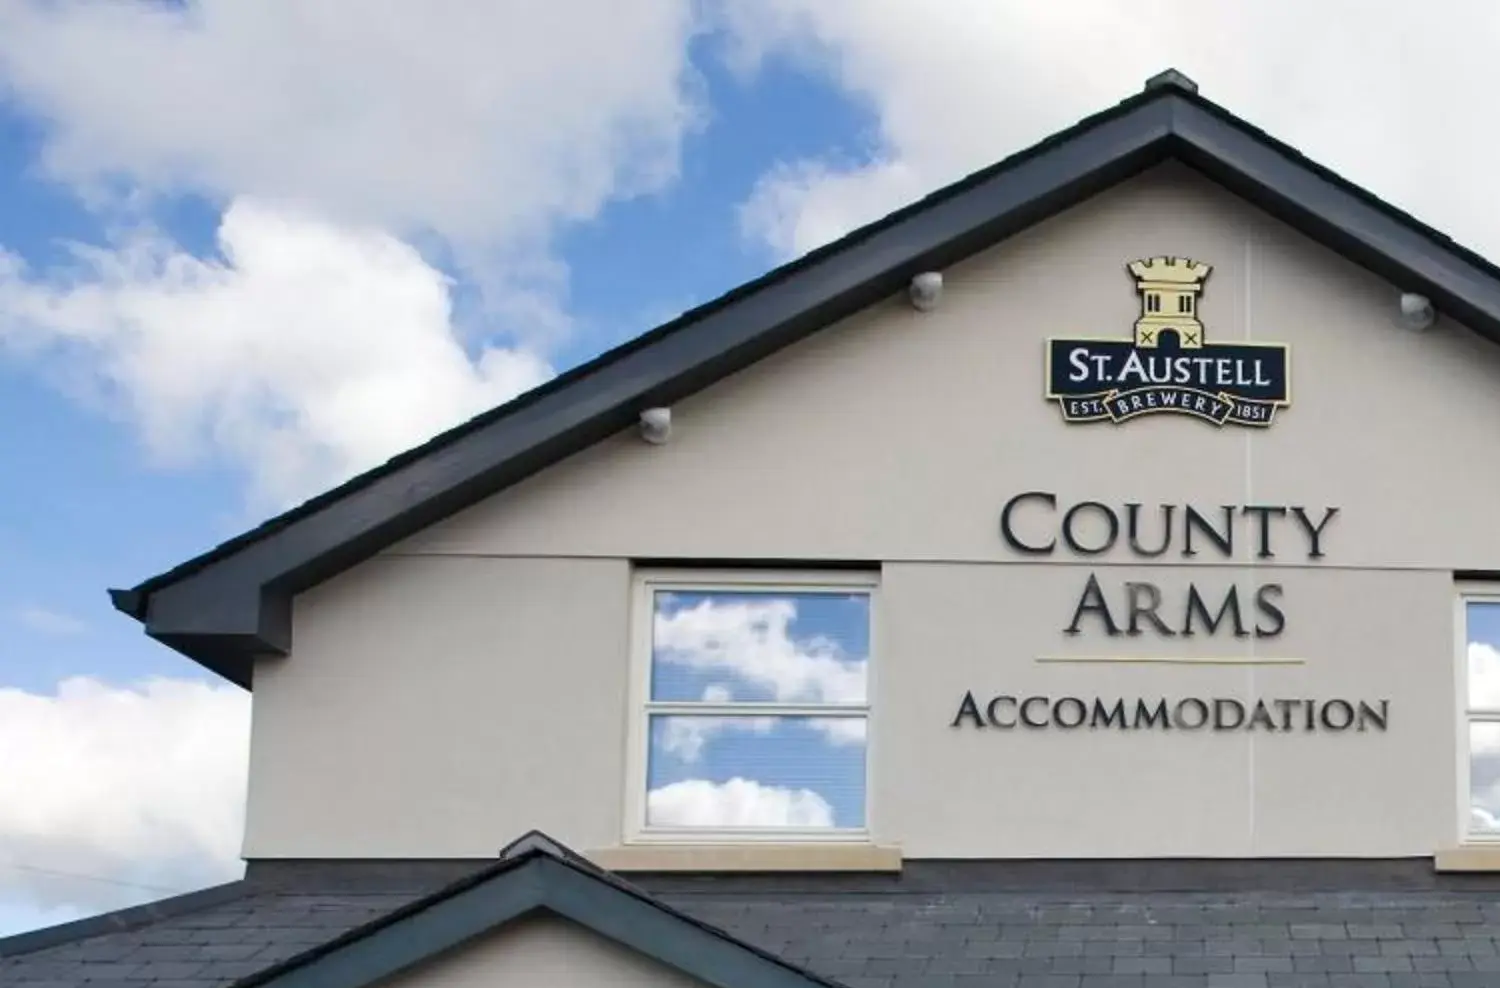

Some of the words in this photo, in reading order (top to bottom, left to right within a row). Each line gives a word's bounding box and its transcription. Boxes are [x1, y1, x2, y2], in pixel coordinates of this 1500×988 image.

[1117, 349, 1272, 387] AUSTELL
[1117, 391, 1222, 417] BREWERY
[1236, 404, 1266, 419] 1851
[1000, 491, 1341, 559] COUNTY
[1063, 571, 1286, 639] ARMS
[950, 689, 1390, 733] ACCOMMODATION
